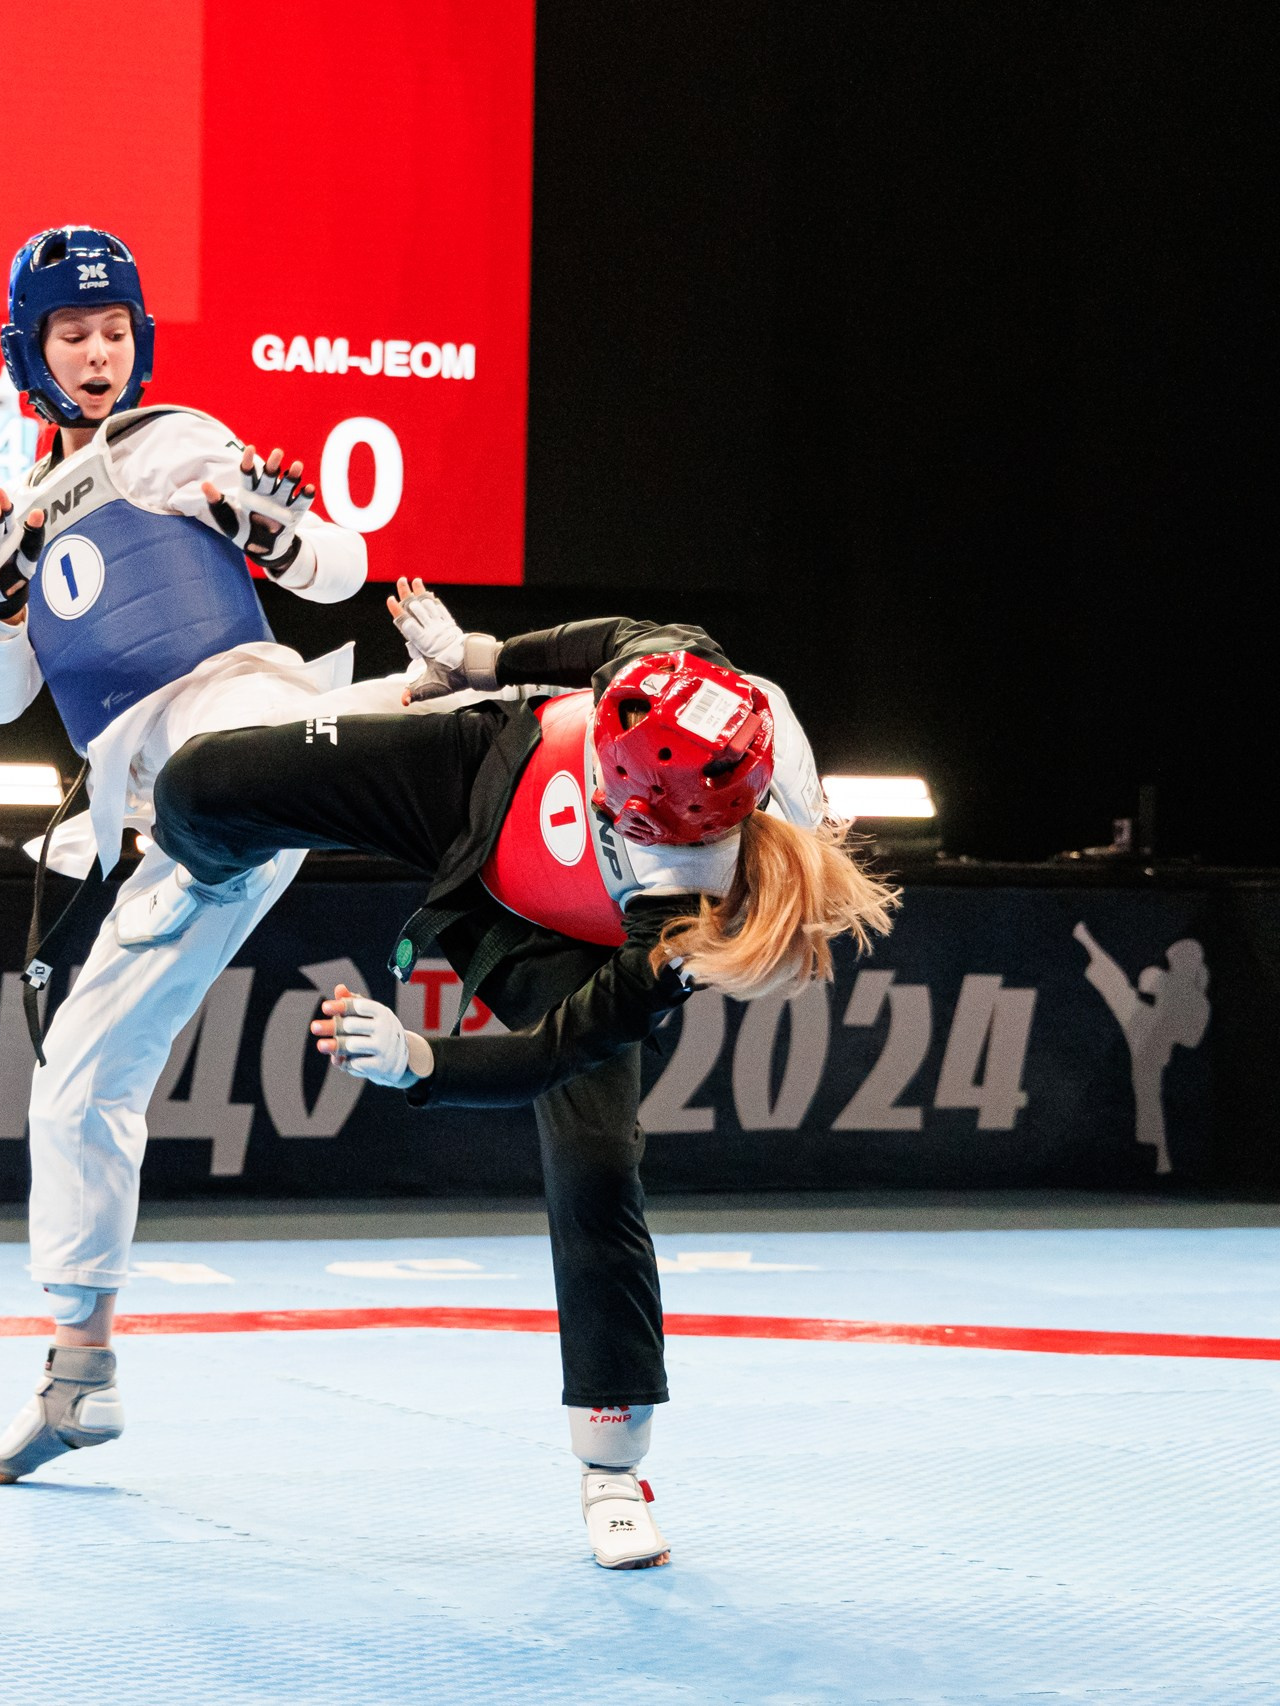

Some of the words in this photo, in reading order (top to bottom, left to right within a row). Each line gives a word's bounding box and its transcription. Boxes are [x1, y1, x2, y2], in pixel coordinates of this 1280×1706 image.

[79, 280, 110, 290] KPNP
[251, 334, 476, 380] GAM-JEOM
[320, 416, 404, 533] 0
[44, 476, 95, 525] NP
[60, 553, 79, 601] 1
[549, 805, 577, 828] 1
[595, 808, 623, 881] NP
[637, 969, 1038, 1133] 2024
[589, 1414, 632, 1423] KPNP
